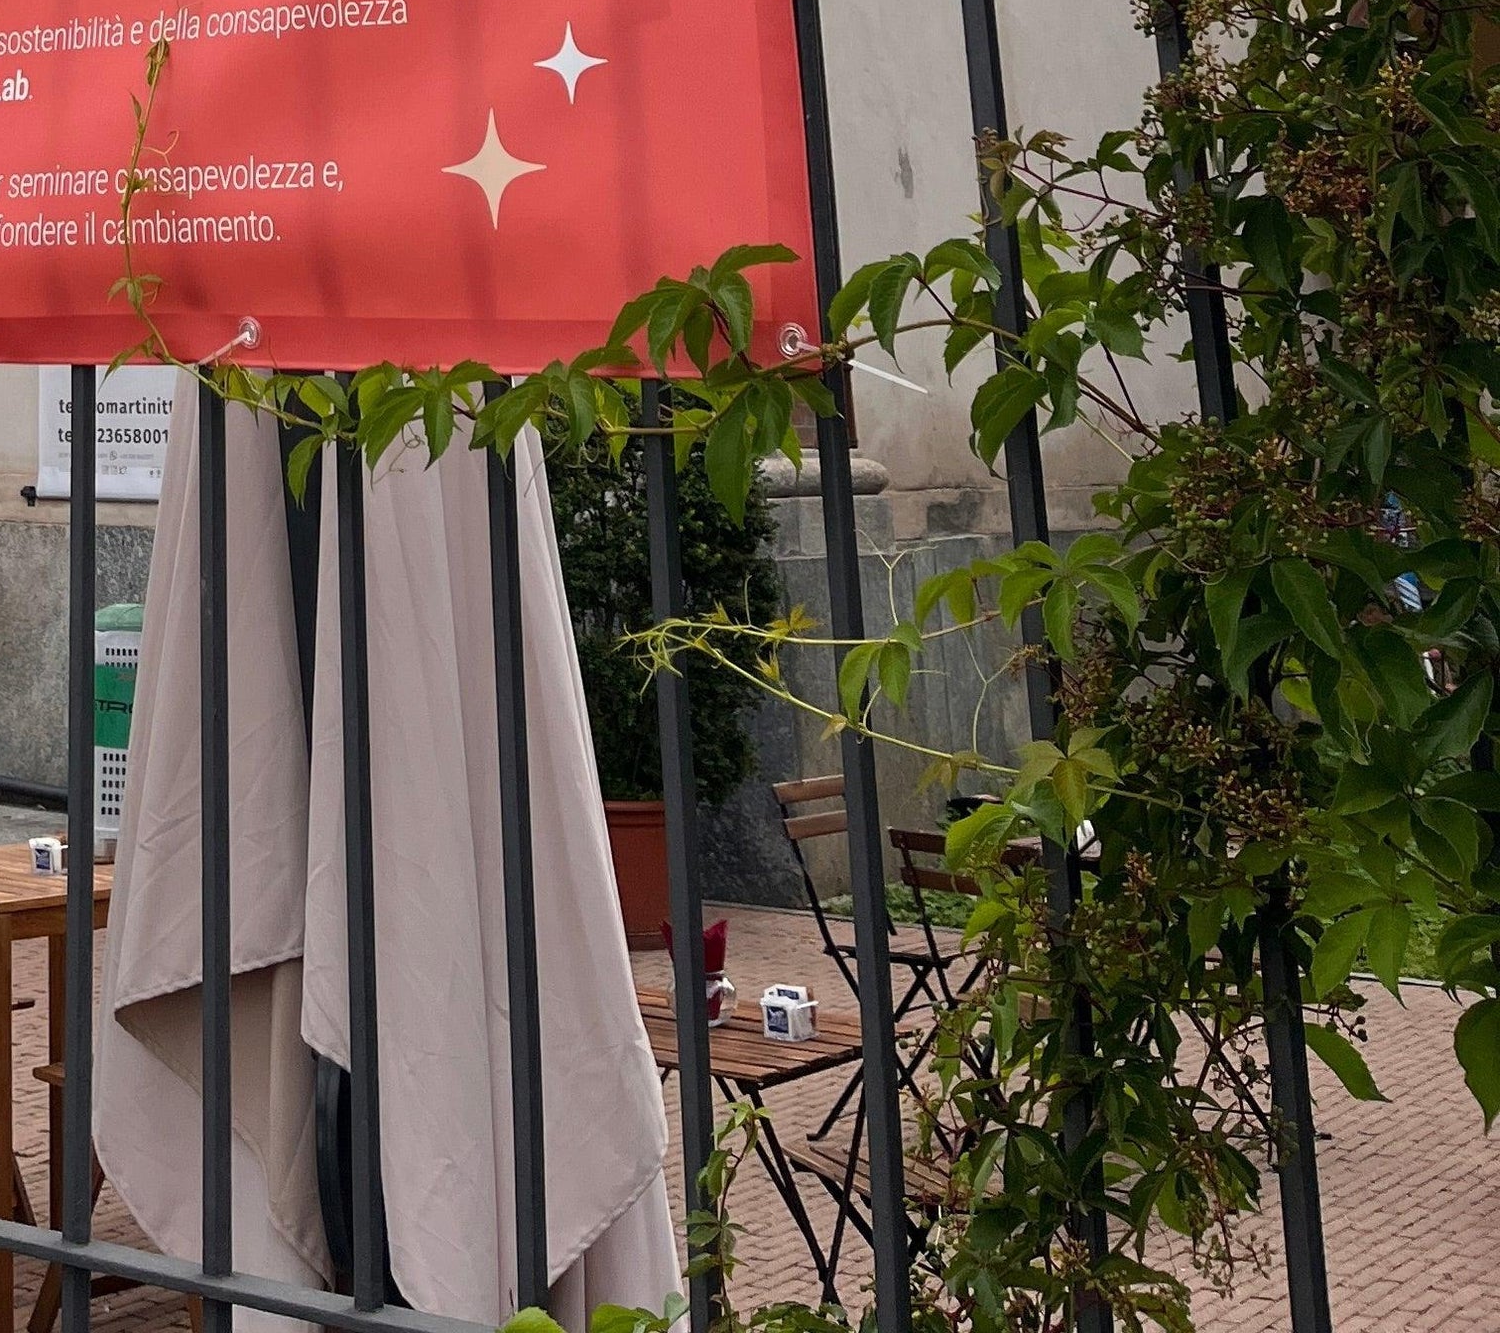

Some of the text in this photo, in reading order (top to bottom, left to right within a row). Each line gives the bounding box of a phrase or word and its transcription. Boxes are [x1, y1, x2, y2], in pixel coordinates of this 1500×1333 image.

[130, 24, 144, 45] e
[150, 7, 200, 42] della
[8, 165, 109, 199] seminare
[323, 160, 344, 192] e,
[84, 211, 97, 246] il
[102, 209, 282, 245] cambiamento.
